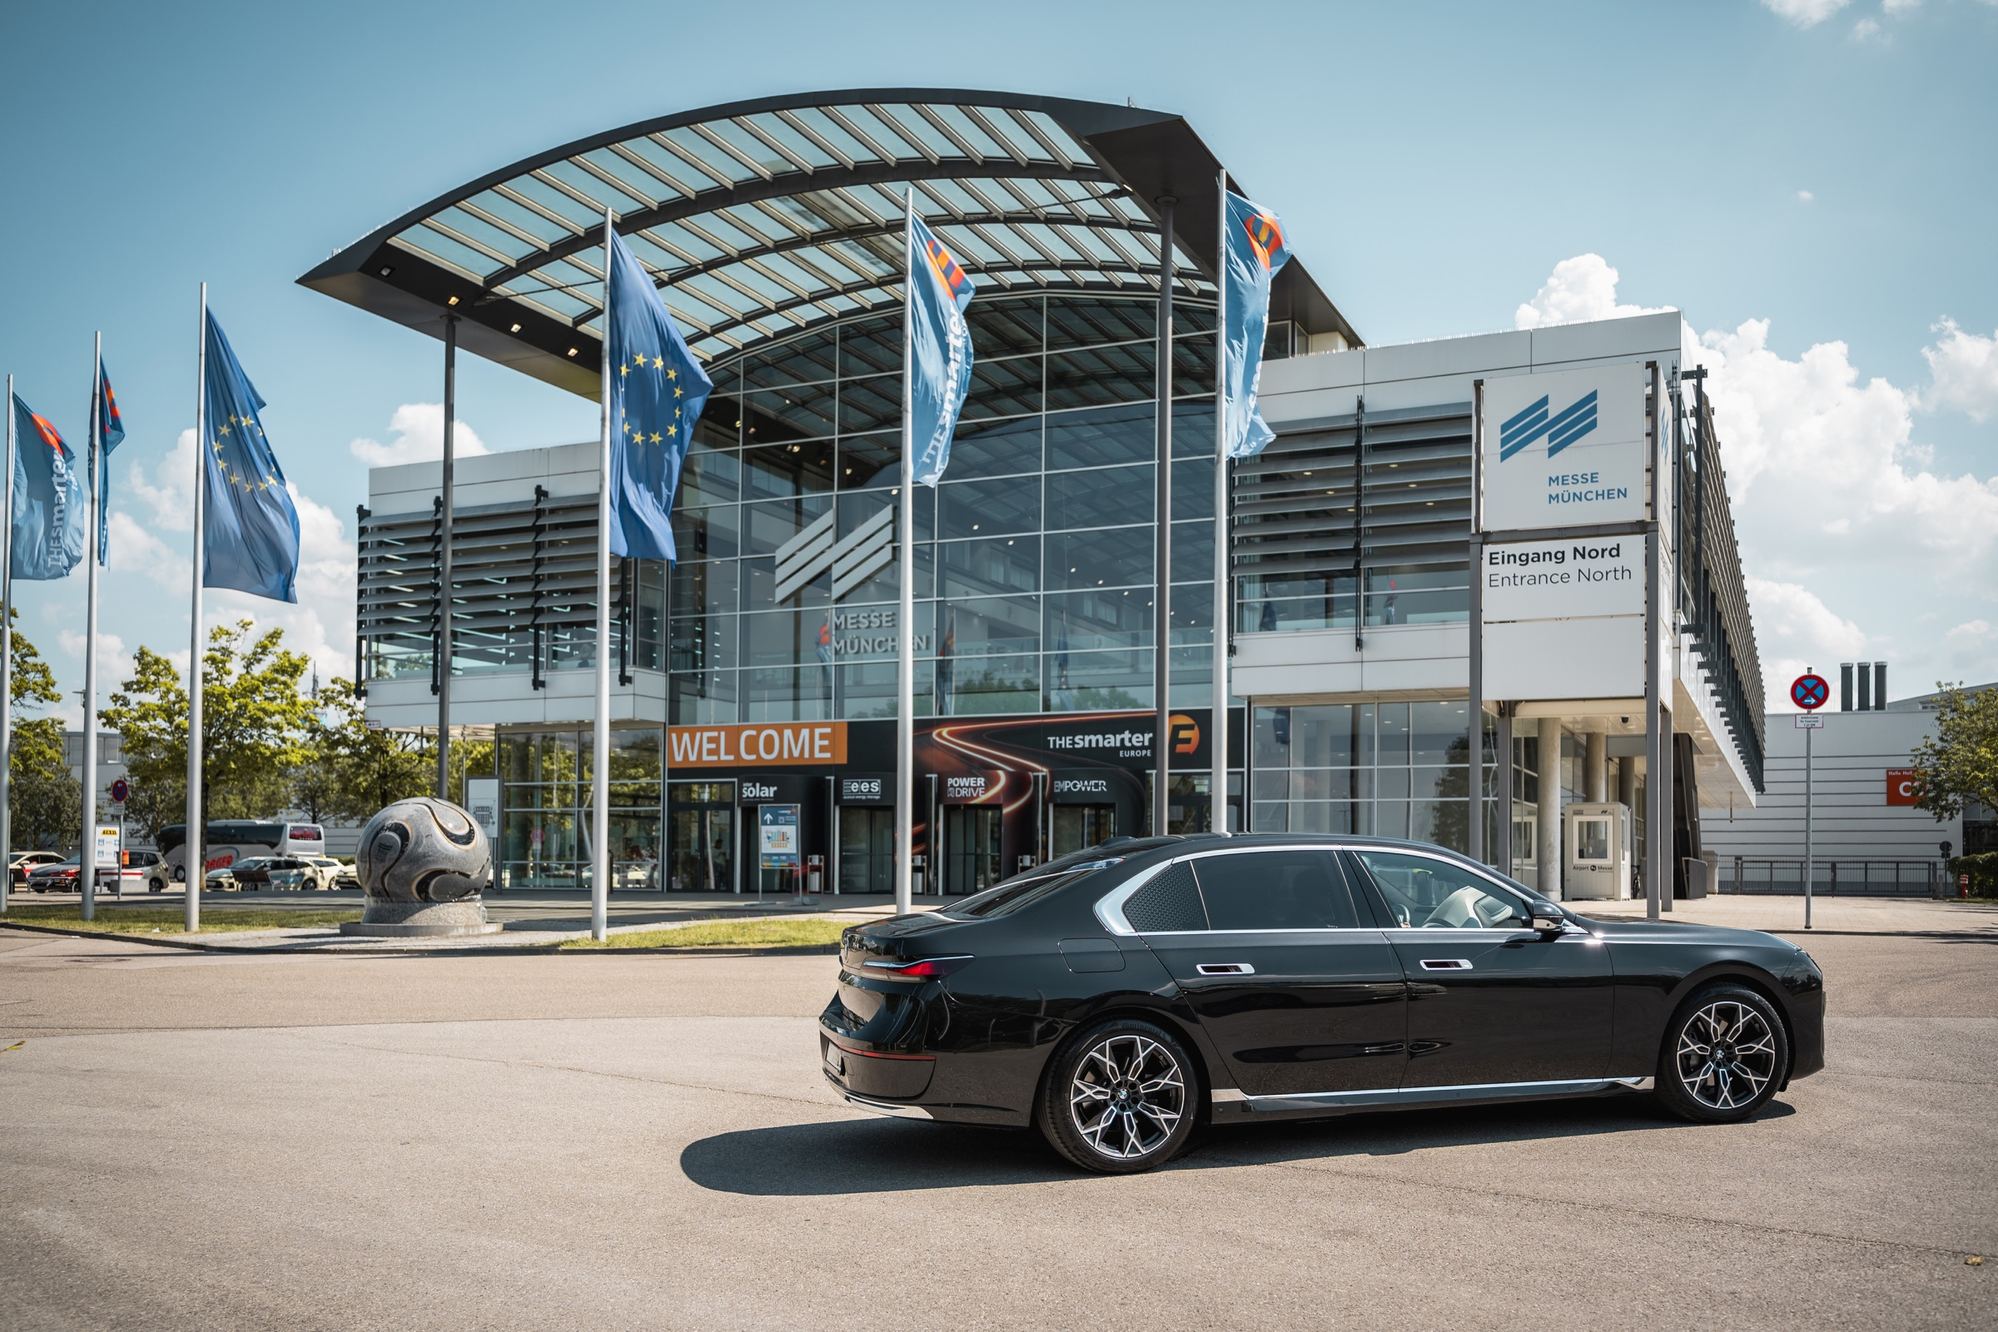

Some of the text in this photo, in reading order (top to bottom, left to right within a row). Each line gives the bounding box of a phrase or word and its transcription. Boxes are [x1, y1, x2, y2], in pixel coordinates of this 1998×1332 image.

[1548, 472, 1599, 487] MESSE
[1548, 487, 1628, 504] MÜNCHEN
[1489, 543, 1621, 566] Eingang Nord
[1489, 565, 1632, 588] Entrance North
[834, 611, 893, 630] MESSE
[834, 635, 926, 654] MÜNCHN
[671, 728, 832, 762] WELCOME
[1119, 749, 1152, 758] EUROPE
[742, 782, 778, 798] solar
[851, 782, 879, 793] ees
[947, 777, 985, 787] POWER
